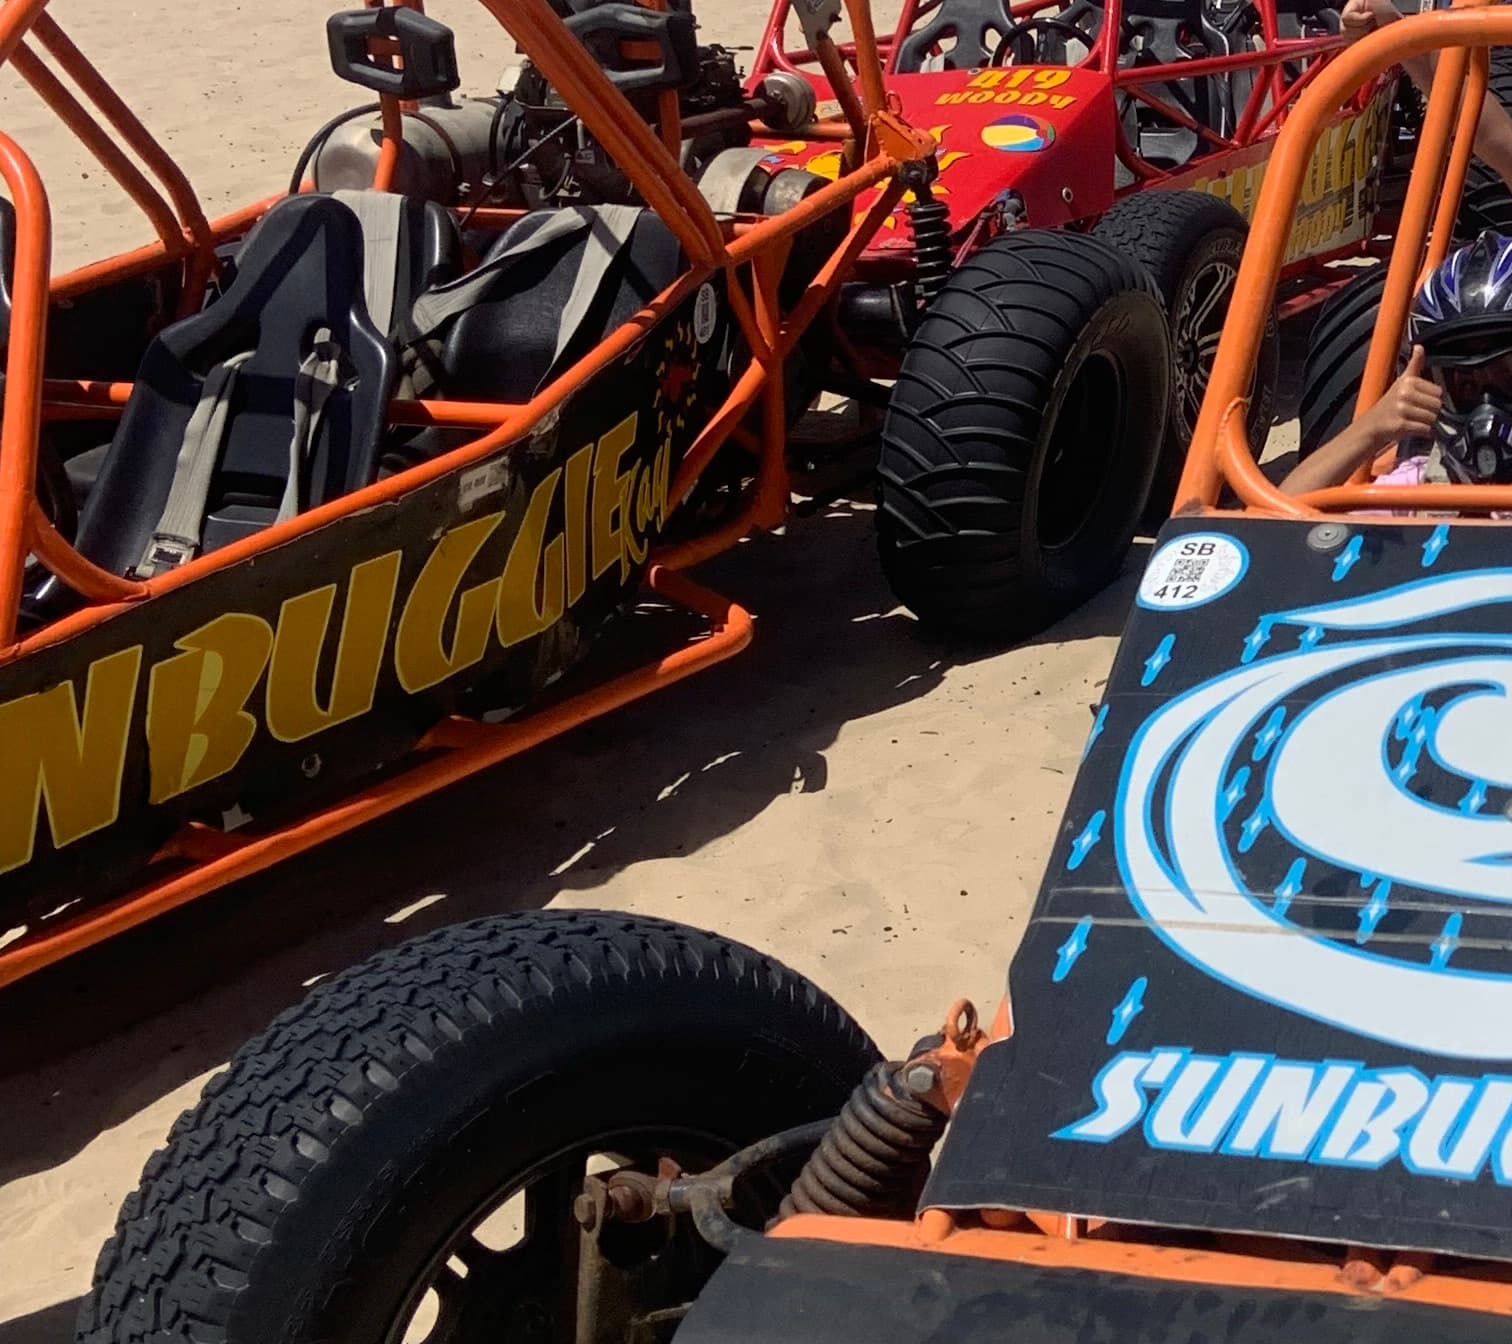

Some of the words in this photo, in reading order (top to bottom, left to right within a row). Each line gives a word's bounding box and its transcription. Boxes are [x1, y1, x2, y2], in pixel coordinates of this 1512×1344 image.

[966, 68, 1072, 89] 419
[934, 90, 1077, 109] WOODY
[1180, 542, 1217, 556] SB
[1153, 584, 1199, 599] 412
